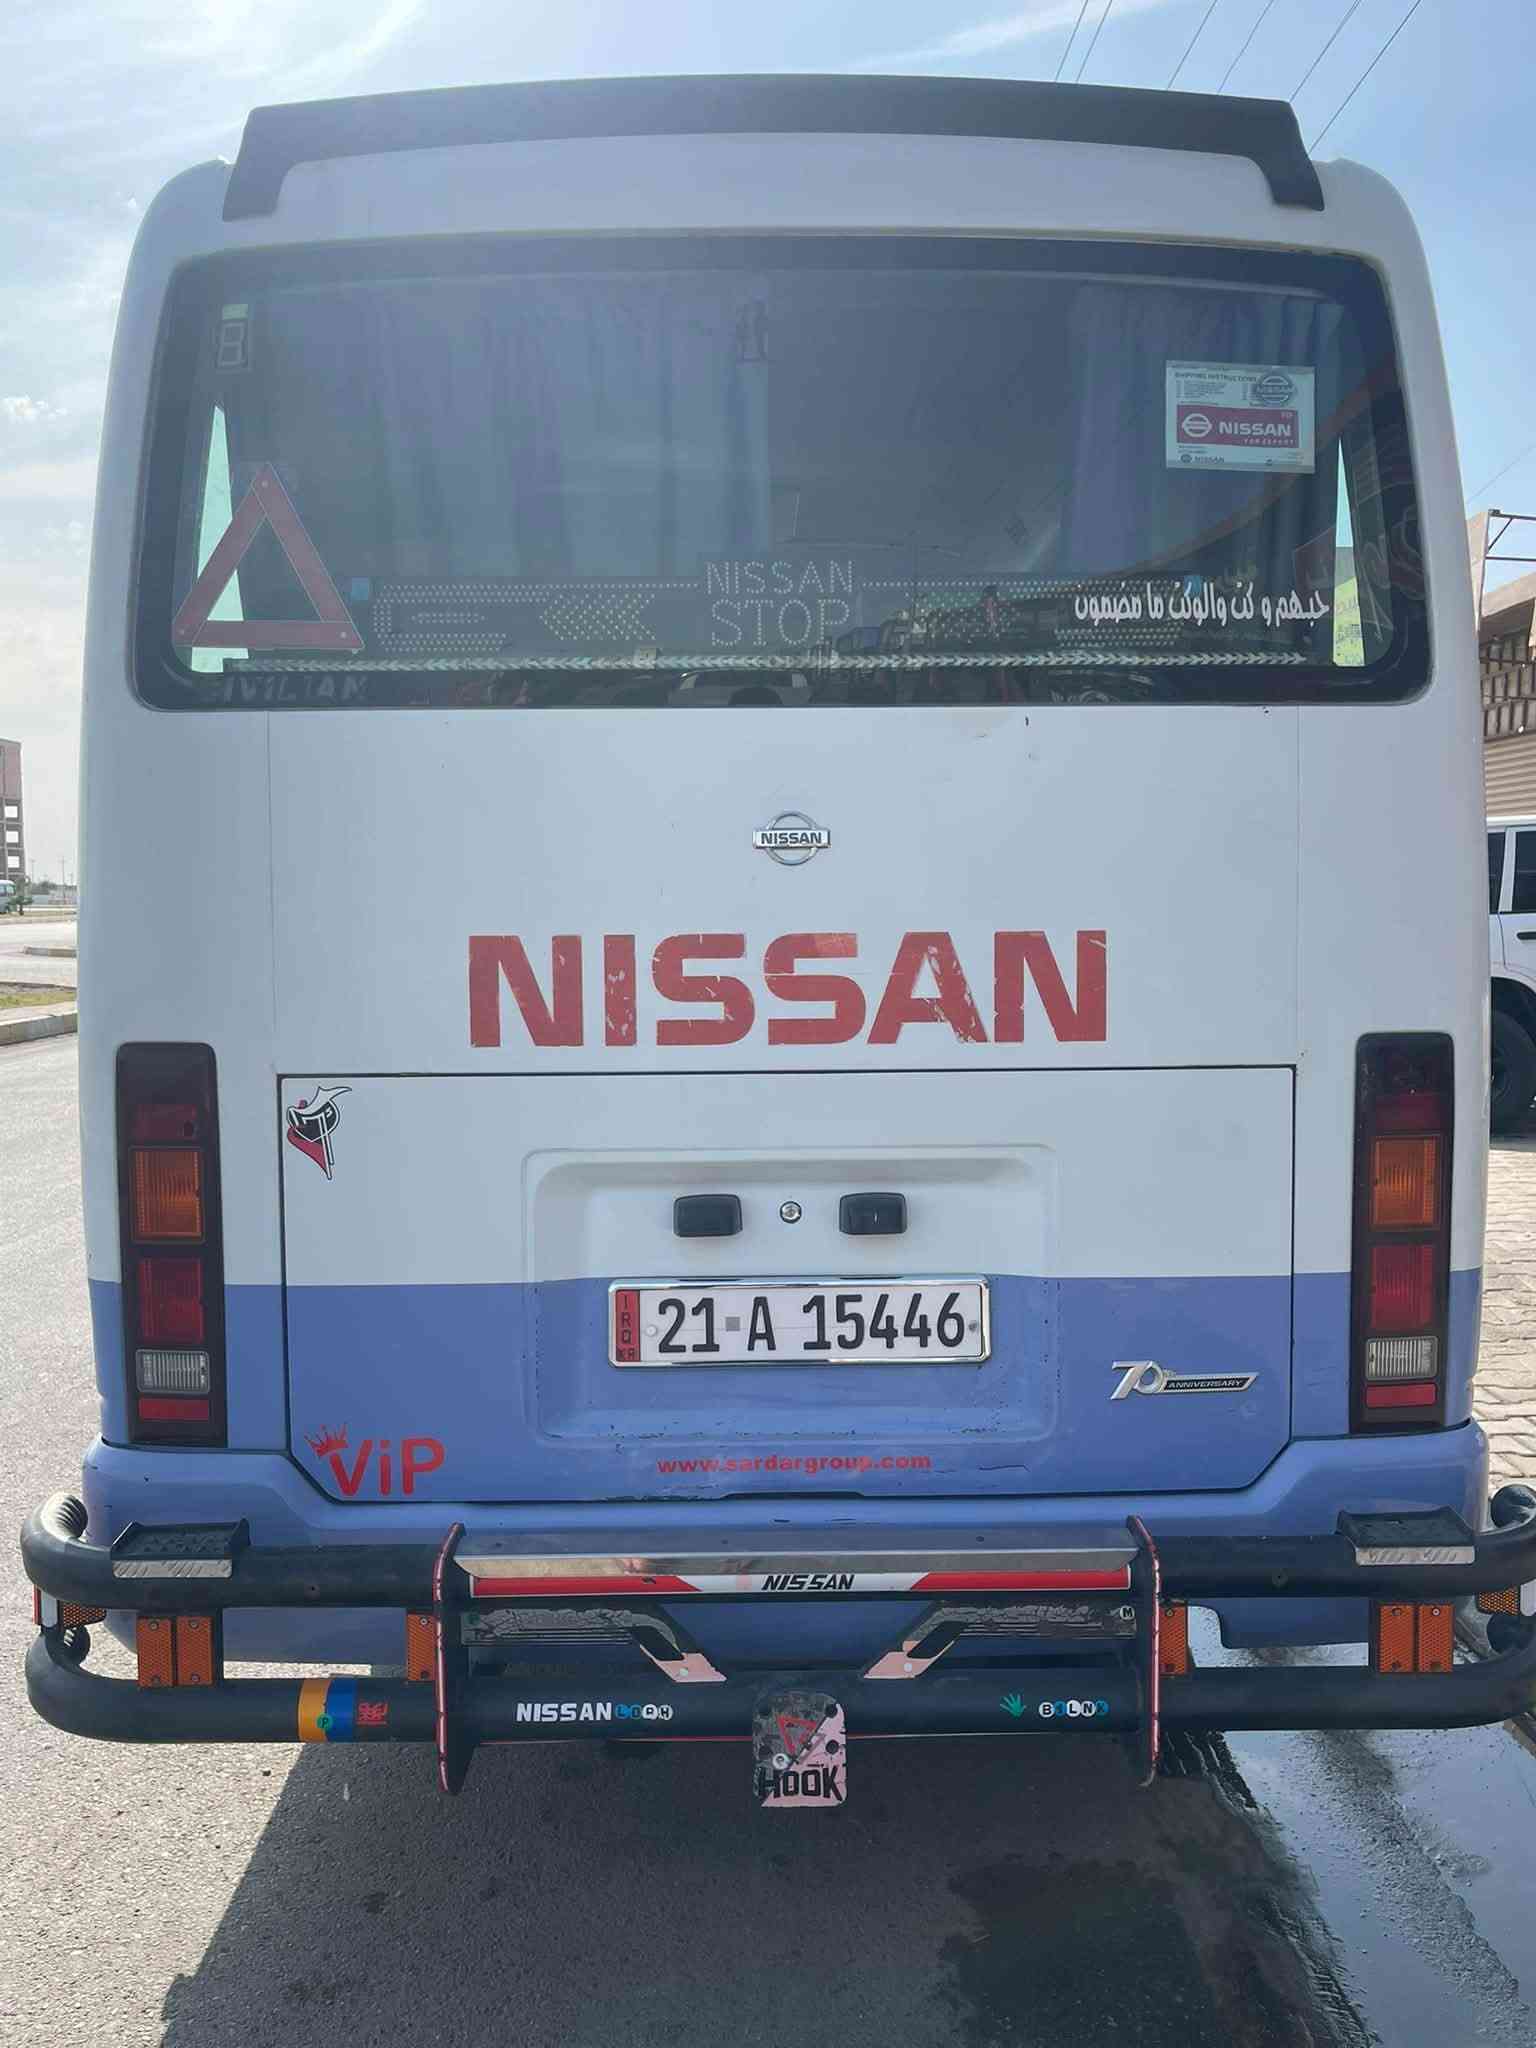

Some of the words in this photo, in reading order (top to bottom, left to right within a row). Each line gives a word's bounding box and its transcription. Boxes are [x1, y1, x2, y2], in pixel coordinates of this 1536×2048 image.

[1218, 421, 1292, 437] NISSAN
[706, 559, 853, 594] NISSAN
[1146, 581, 1164, 621] ما
[711, 598, 850, 647] STOP
[760, 831, 822, 845] NISSAN
[468, 929, 1108, 1047] NISSAN
[657, 1297, 721, 1354] 21
[747, 1296, 777, 1352] A
[802, 1292, 963, 1351] 15446
[1168, 1379, 1244, 1389] ANNIVERSARY
[656, 1454, 932, 1475] www.sardargroup.com
[761, 1573, 855, 1591] NISSAN
[516, 1702, 612, 1722] NISSAN
[759, 1765, 843, 1802] HOOK
